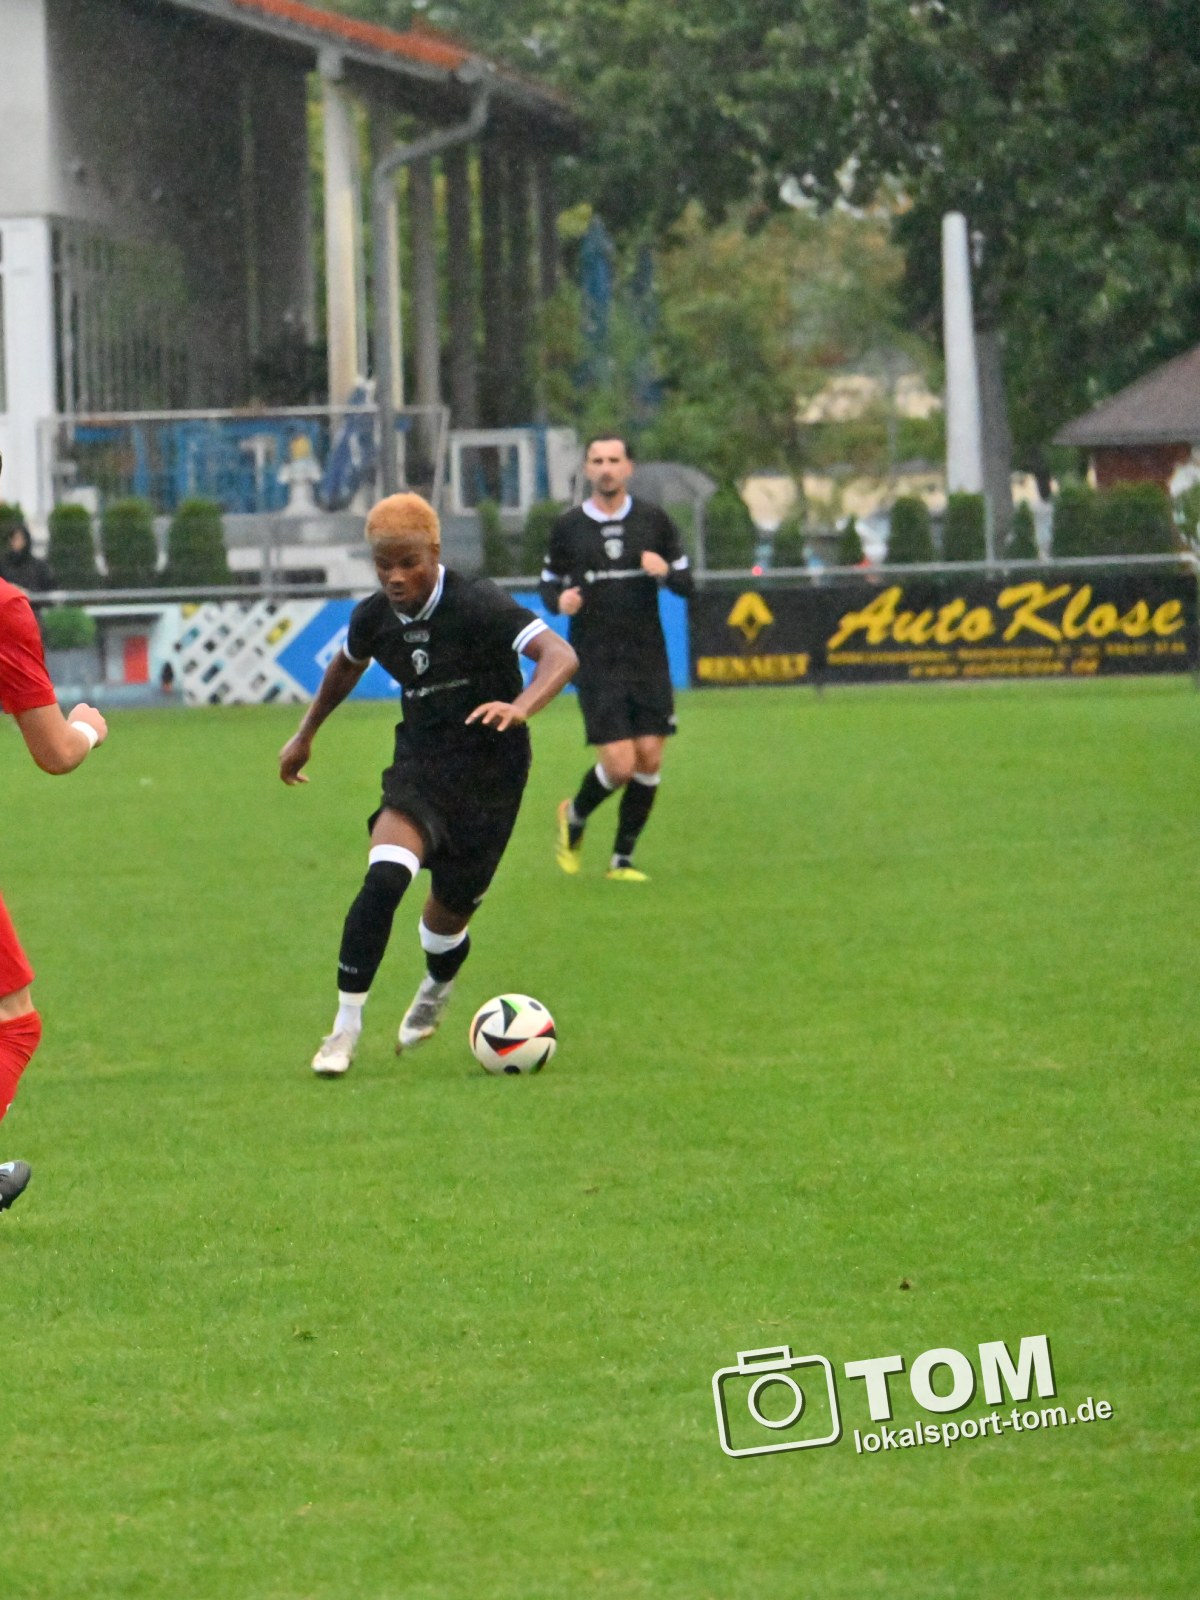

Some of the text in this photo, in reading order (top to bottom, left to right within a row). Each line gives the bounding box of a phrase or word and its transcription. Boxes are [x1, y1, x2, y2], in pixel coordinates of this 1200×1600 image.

[826, 581, 1186, 650] Auto Klose
[697, 653, 811, 682] RENAULT
